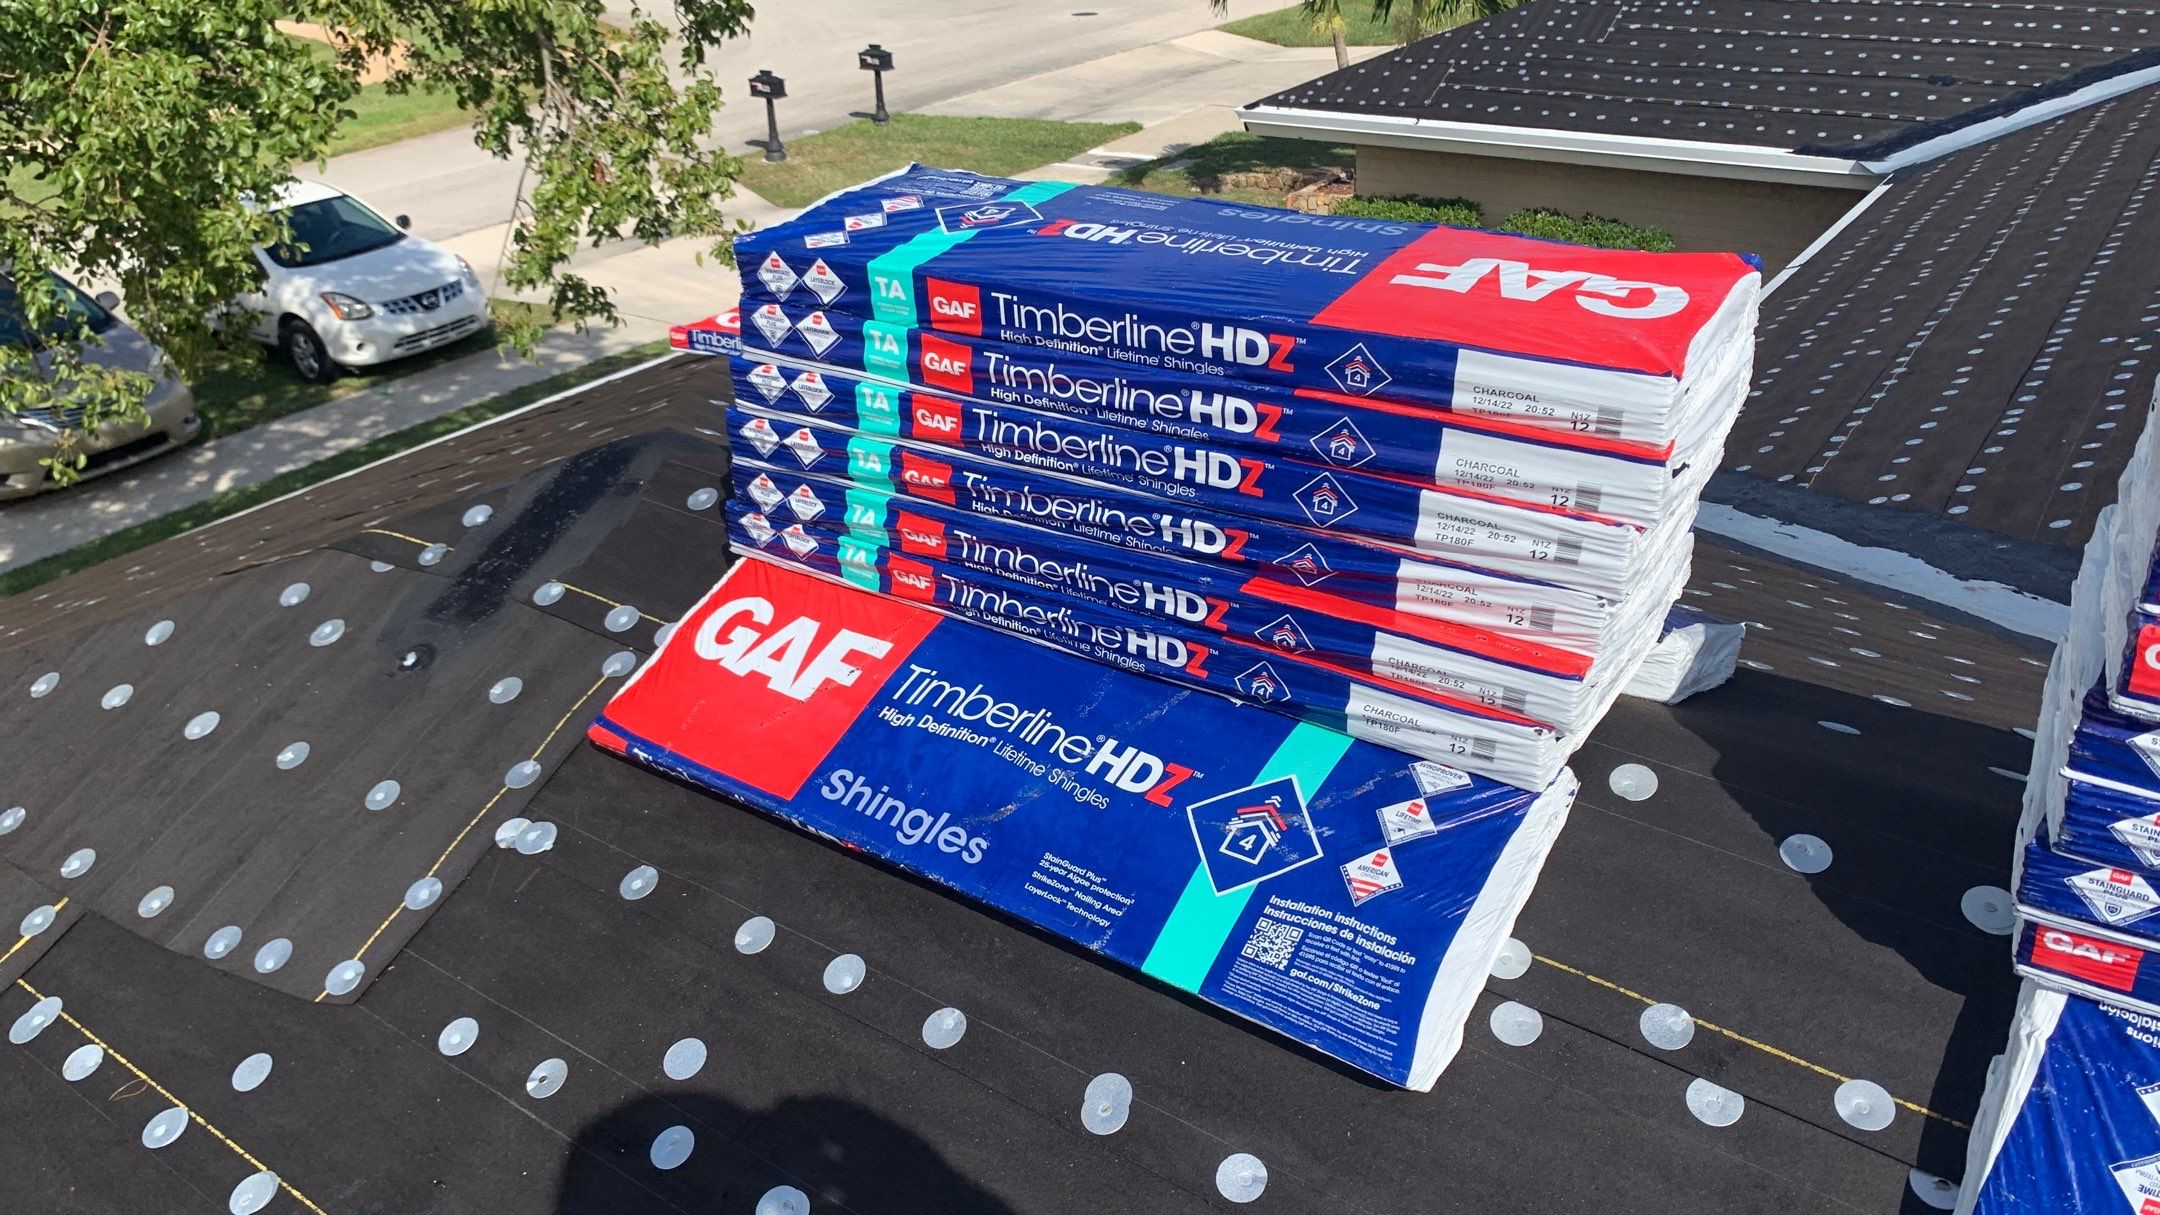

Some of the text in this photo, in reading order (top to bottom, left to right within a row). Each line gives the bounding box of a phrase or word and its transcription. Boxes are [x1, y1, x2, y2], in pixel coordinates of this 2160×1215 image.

[1217, 208, 1409, 236] Shingles
[875, 276, 907, 300] TA
[1389, 258, 1690, 319] GAF
[933, 296, 976, 319] GAF
[692, 330, 741, 349] Timberl
[869, 329, 900, 356] TA
[1000, 329, 1032, 344] High
[1164, 356, 1224, 375] Shingles
[924, 352, 966, 376] GAF
[1353, 374, 1362, 383] 4
[861, 387, 890, 411] TA
[990, 387, 1020, 402] High
[1473, 385, 1540, 403] CHARCOAL
[1472, 396, 1555, 416] 12/14/22 20:52
[916, 408, 957, 432] GAF
[1570, 421, 1590, 433] 12
[853, 448, 881, 472] TA
[1337, 447, 1345, 455] 4
[904, 469, 945, 488] GAF
[982, 443, 1011, 458] High
[1138, 475, 1196, 497] Shingles
[1456, 458, 1521, 478] CHARCOAL
[1454, 469, 1535, 489] 12/14/22 20:52
[1456, 478, 1496, 490] TP180F
[972, 500, 999, 516] High
[1320, 501, 1328, 510] 4
[1551, 494, 1569, 507] 12
[852, 504, 875, 527] TA
[1437, 512, 1502, 531] CHARCOAL
[901, 527, 942, 548] GAF
[1435, 533, 1475, 547] TP180F
[1436, 521, 1517, 543] 12/14/22 20:52
[845, 544, 867, 564] TA
[1529, 549, 1548, 560] 12
[892, 569, 931, 590] GAF
[1415, 584, 1453, 599] 12/14/22
[1464, 596, 1492, 608] 20:52
[1415, 594, 1454, 607] TP180F
[1506, 614, 1524, 626] 12
[694, 596, 895, 703] GAF
[1094, 645, 1146, 673] Shingles
[1388, 657, 1450, 676] CHARCOAL
[1438, 676, 1465, 689] 20:52
[1479, 695, 1496, 706] 12
[1363, 704, 1421, 728] CHARCOAL
[878, 705, 916, 728] High
[1048, 768, 1110, 810] Shingles
[1449, 743, 1466, 755] 12
[820, 768, 992, 865] Shingles
[1395, 810, 1422, 824] LIFETIME
[2132, 823, 2160, 836] STAIN
[1238, 834, 1257, 851] 4
[1039, 859, 1068, 877] 25-year
[1067, 872, 1091, 887] Algae
[1043, 852, 1087, 876] StainGuard
[1357, 864, 1390, 878] AMERICAN
[2088, 877, 2150, 901] STAINGUARD
[1074, 890, 1103, 910] Nailing
[1102, 903, 1124, 917] Area
[1066, 901, 1112, 928] Technology
[1269, 894, 1398, 946] Installation instructions
[1263, 905, 1417, 966] Instrucciones de instalación
[1307, 932, 1322, 942] Scan
[1322, 935, 1332, 944] QR
[1331, 939, 1346, 949] Code
[2043, 930, 2131, 965] GAF
[1289, 968, 1381, 1010] gaf.com/StrikeZone
[2099, 1000, 2160, 1032] stalación
[2126, 1025, 2160, 1048] tions
[2138, 1183, 2160, 1199] TIME
